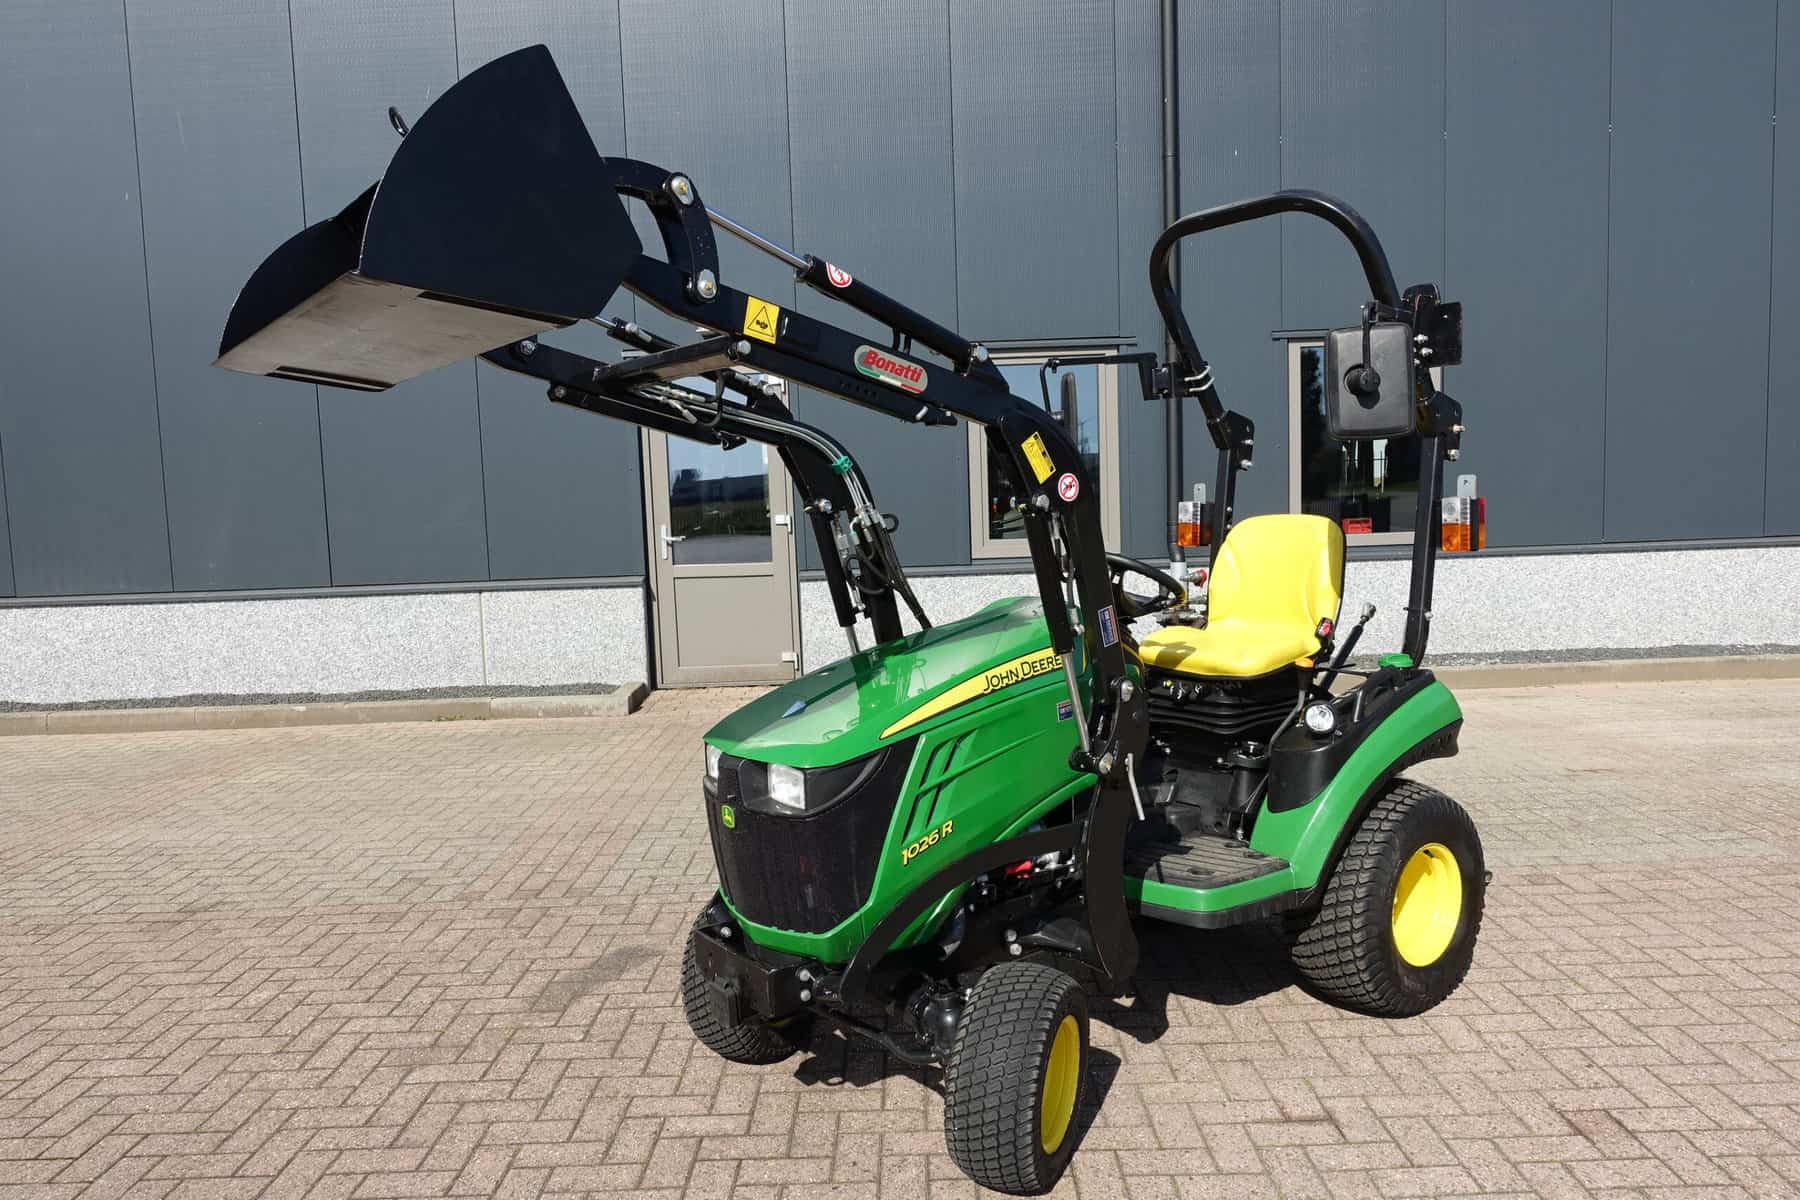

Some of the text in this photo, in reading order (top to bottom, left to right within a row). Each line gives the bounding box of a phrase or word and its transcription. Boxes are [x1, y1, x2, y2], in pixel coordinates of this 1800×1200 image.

[864, 349, 923, 383] Bonatti
[983, 655, 1063, 692] JOHN DEERE
[902, 819, 954, 866] 1026 R
